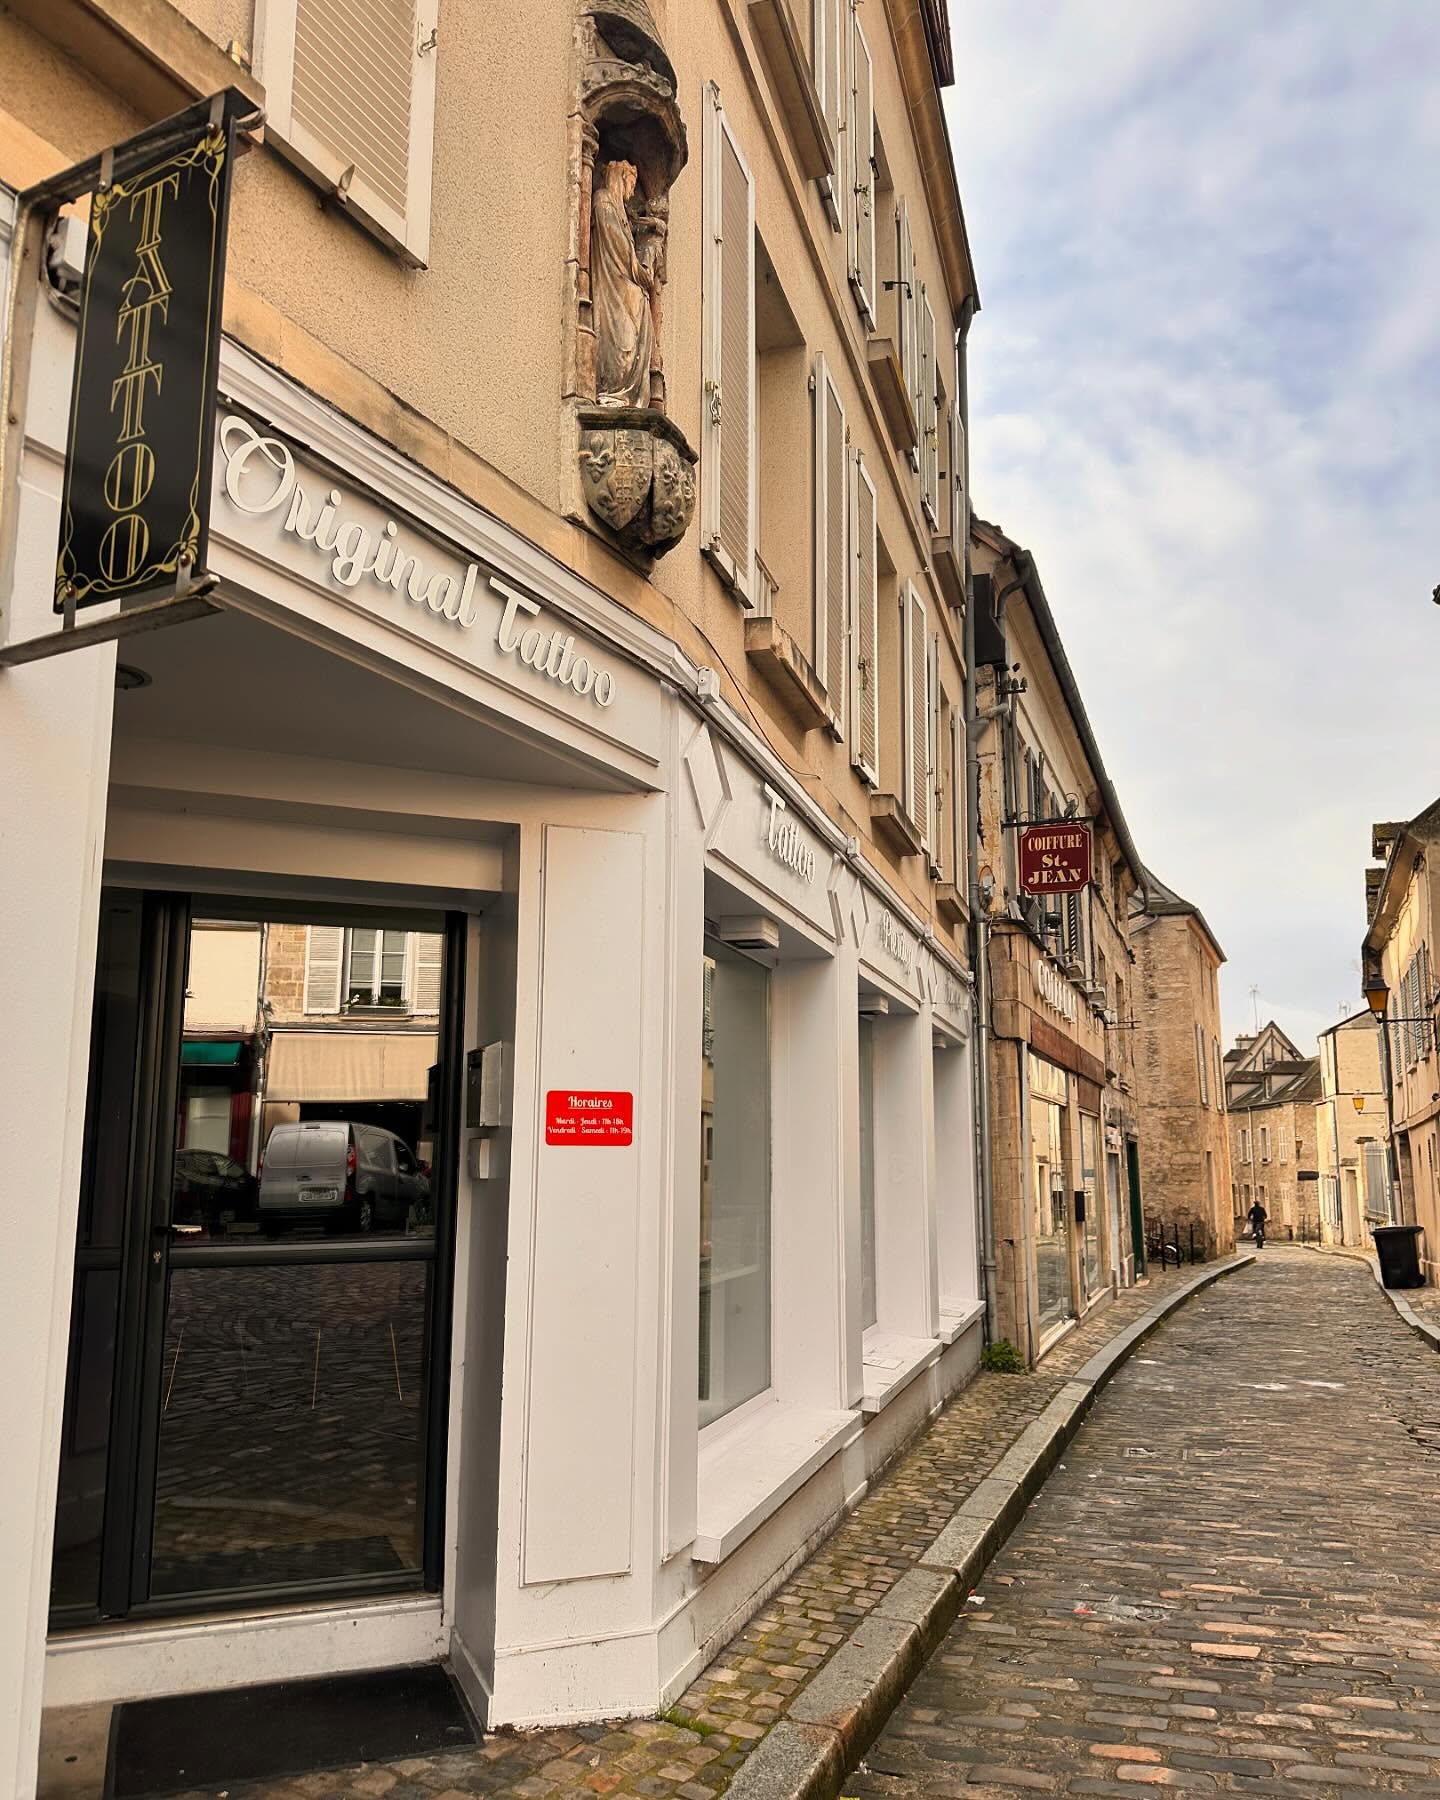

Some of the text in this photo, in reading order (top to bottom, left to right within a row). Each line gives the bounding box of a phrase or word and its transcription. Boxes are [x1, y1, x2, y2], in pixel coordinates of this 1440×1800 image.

[98, 171, 182, 584] TATTOO
[219, 414, 618, 709] Original Tattoo
[763, 781, 818, 887] Tattoo
[1027, 833, 1083, 853] COIFFURE
[1041, 853, 1069, 869] St.
[1027, 868, 1083, 885] JEAN
[567, 1095, 613, 1108] Horaires
